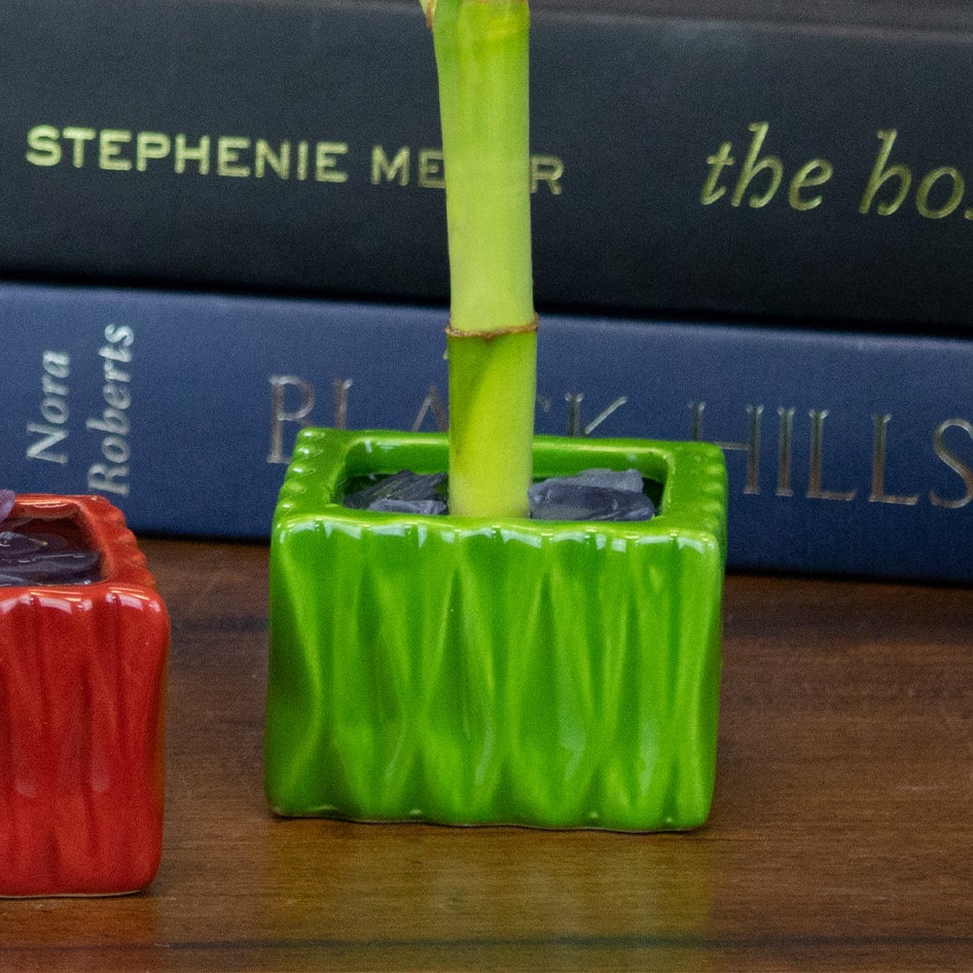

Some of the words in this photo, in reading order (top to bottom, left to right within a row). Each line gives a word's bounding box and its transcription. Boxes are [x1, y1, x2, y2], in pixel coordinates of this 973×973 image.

[26, 124, 348, 183] STEPHENIE
[370, 144, 565, 196] MER
[700, 120, 834, 211] the
[857, 129, 973, 219] ho
[26, 349, 70, 465] Nora
[84, 323, 135, 497] Roberts
[688, 401, 973, 509] HILLS
